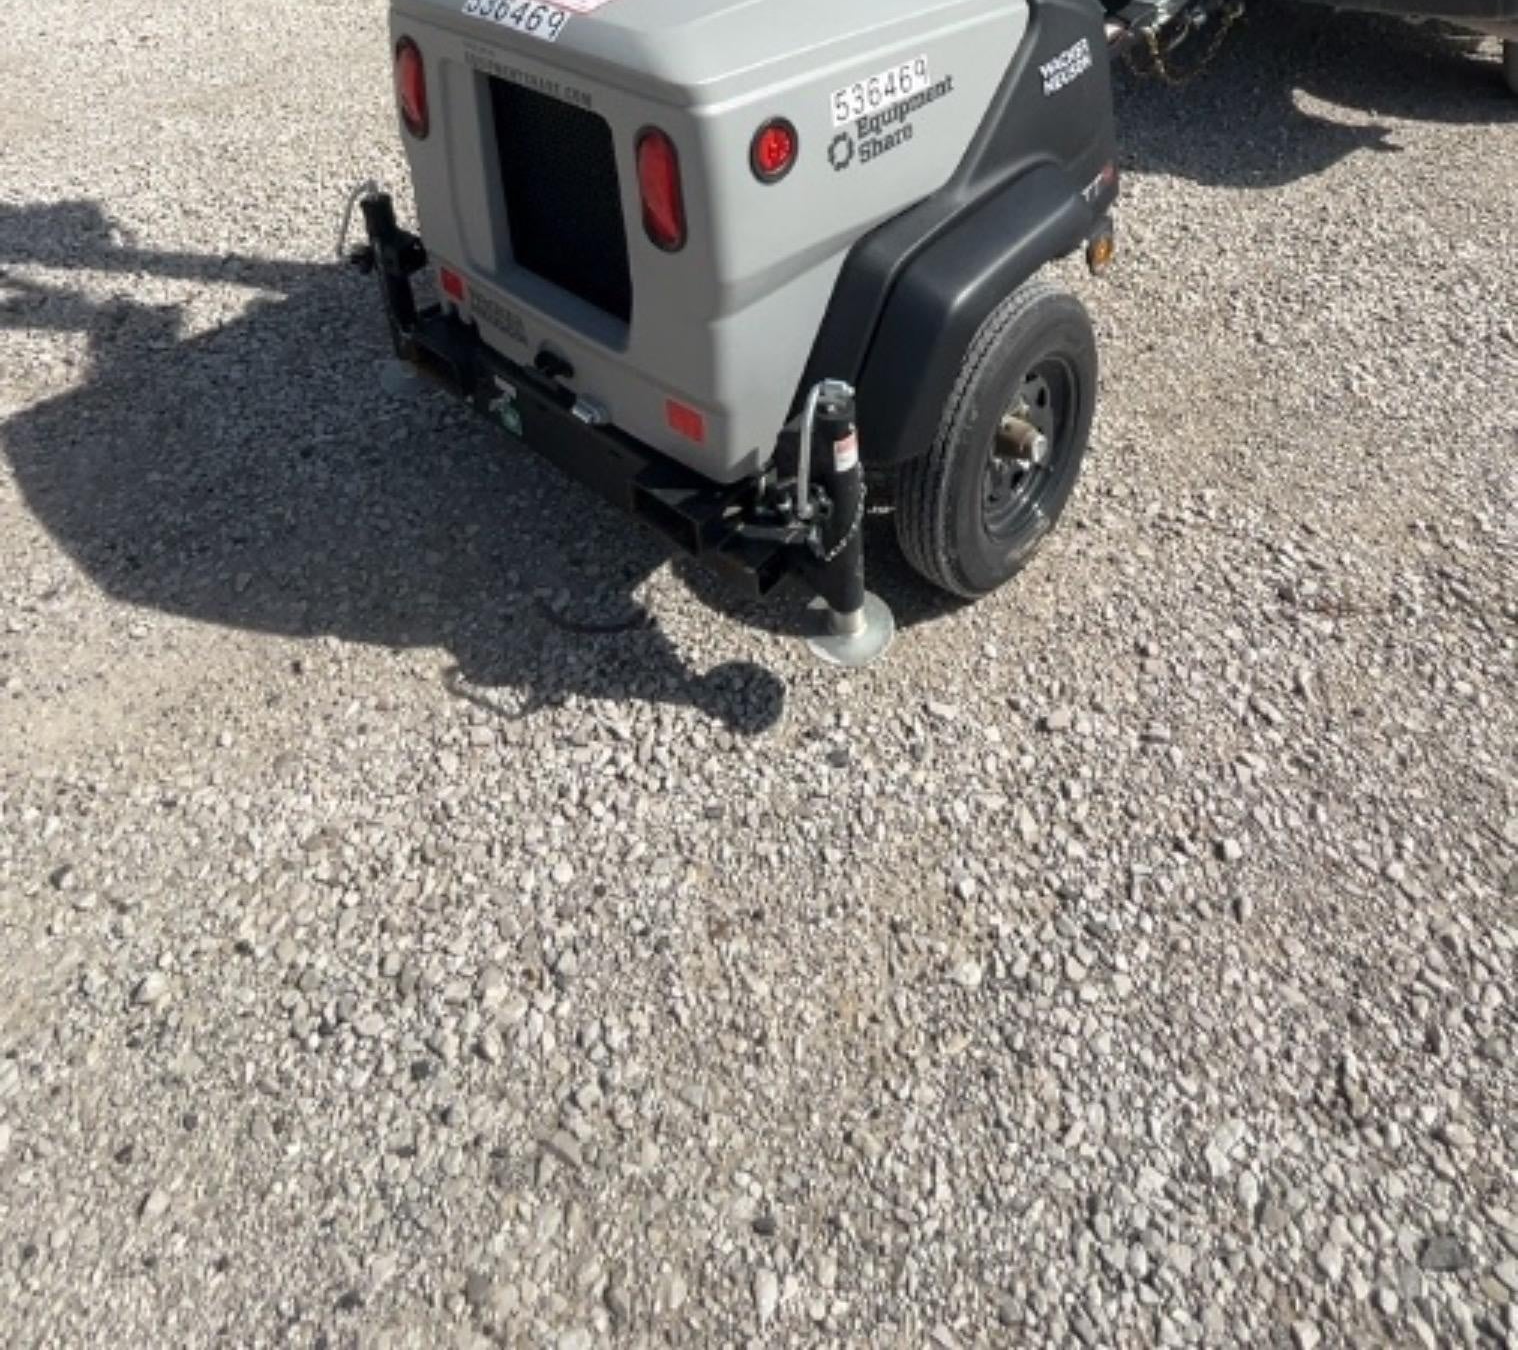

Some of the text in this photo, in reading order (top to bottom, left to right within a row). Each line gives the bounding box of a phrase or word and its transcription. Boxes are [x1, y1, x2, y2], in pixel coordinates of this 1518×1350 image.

[834, 58, 928, 122] 536469
[856, 73, 954, 139] Equipment
[857, 122, 914, 164] Share
